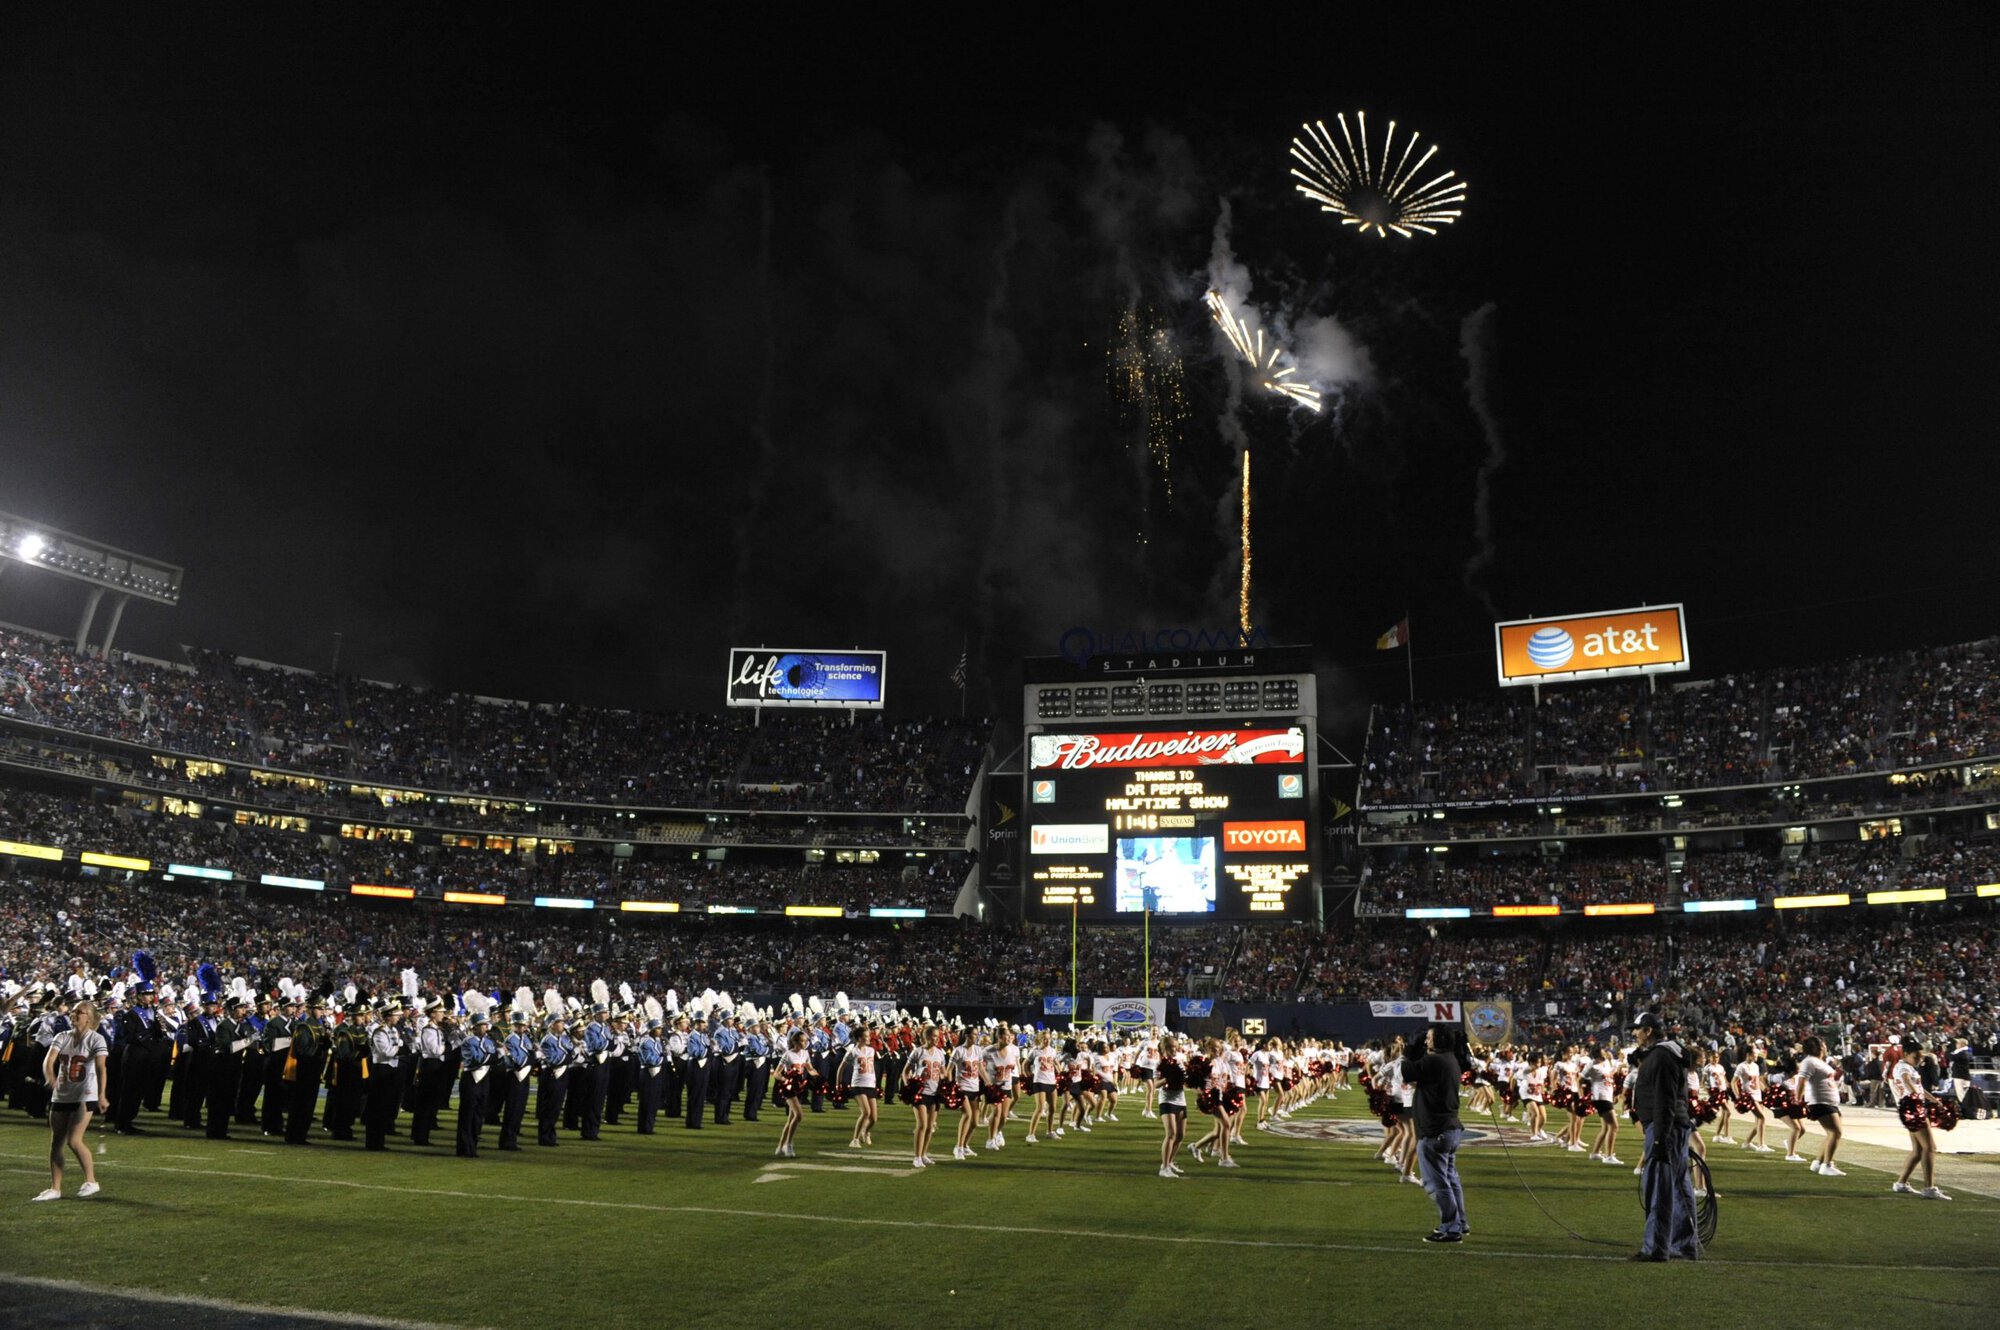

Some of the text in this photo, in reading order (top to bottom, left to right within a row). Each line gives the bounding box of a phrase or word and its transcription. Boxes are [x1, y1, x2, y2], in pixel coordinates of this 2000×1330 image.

[1583, 622, 1660, 657] at&t
[1061, 626, 1270, 669] QUALCOMM
[815, 662, 877, 674] Transforming
[1103, 656, 1254, 669] STADIUM
[732, 654, 783, 697] life
[827, 672, 862, 680] science
[1056, 732, 1237, 769] Budweiser
[1135, 770, 1194, 781] THANKS TO
[1126, 783, 1203, 795] DR PEPPER
[1106, 796, 1228, 810] HALFTIME SHOW
[1160, 817, 1194, 825] SYCUAN
[989, 828, 1017, 841] Sprint
[1227, 829, 1302, 844] TOYOTA
[1110, 1003, 1135, 1013] PACIFIC
[1435, 1003, 1454, 1020] N
[1245, 1019, 1264, 1034] 25
